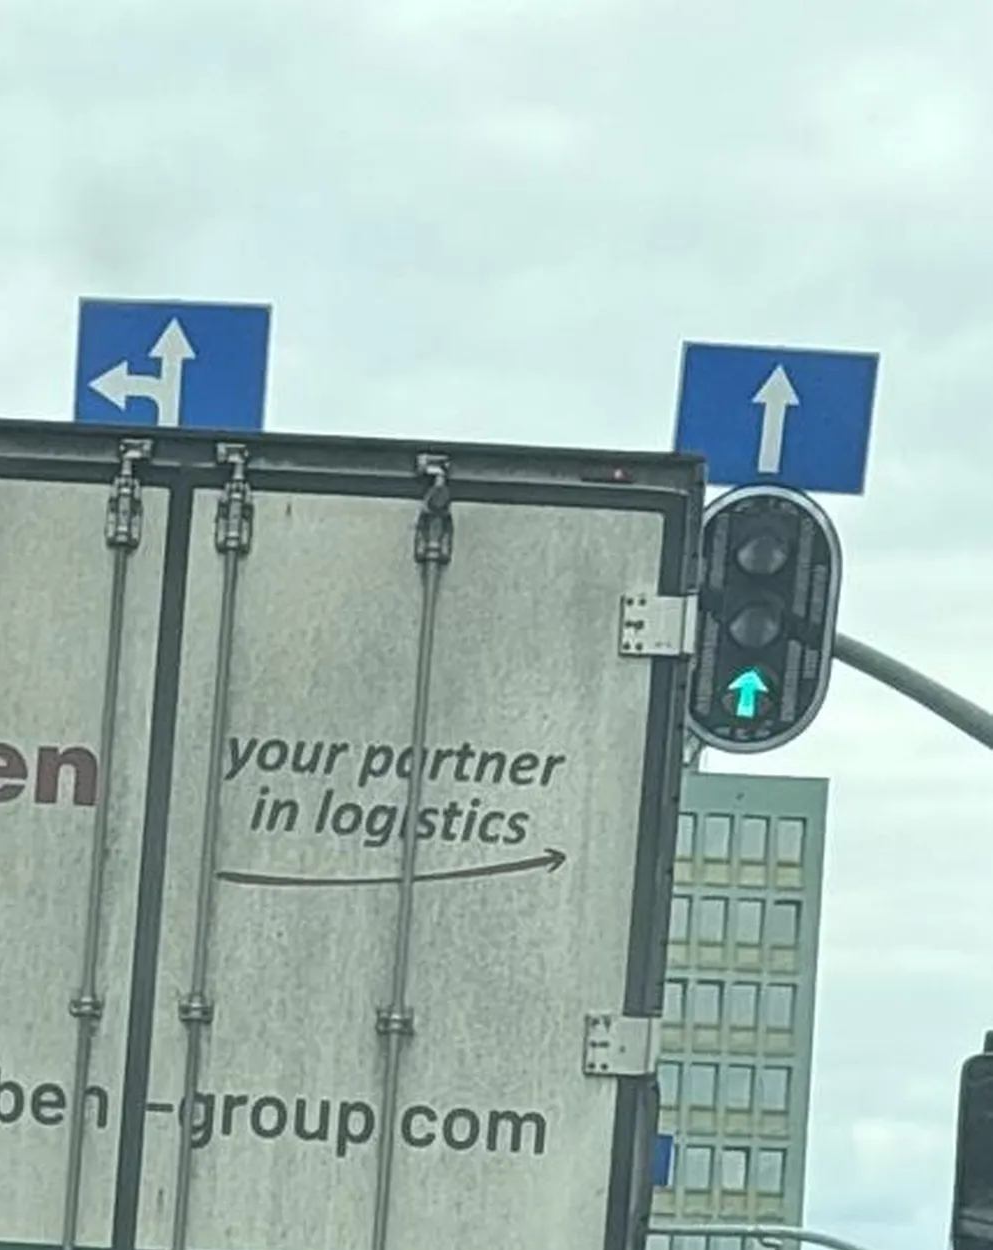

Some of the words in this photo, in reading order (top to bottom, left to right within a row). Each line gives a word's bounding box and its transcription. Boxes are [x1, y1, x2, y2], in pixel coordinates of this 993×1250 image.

[222, 735, 350, 781] your
[357, 742, 567, 788] partner
[250, 784, 300, 832] in
